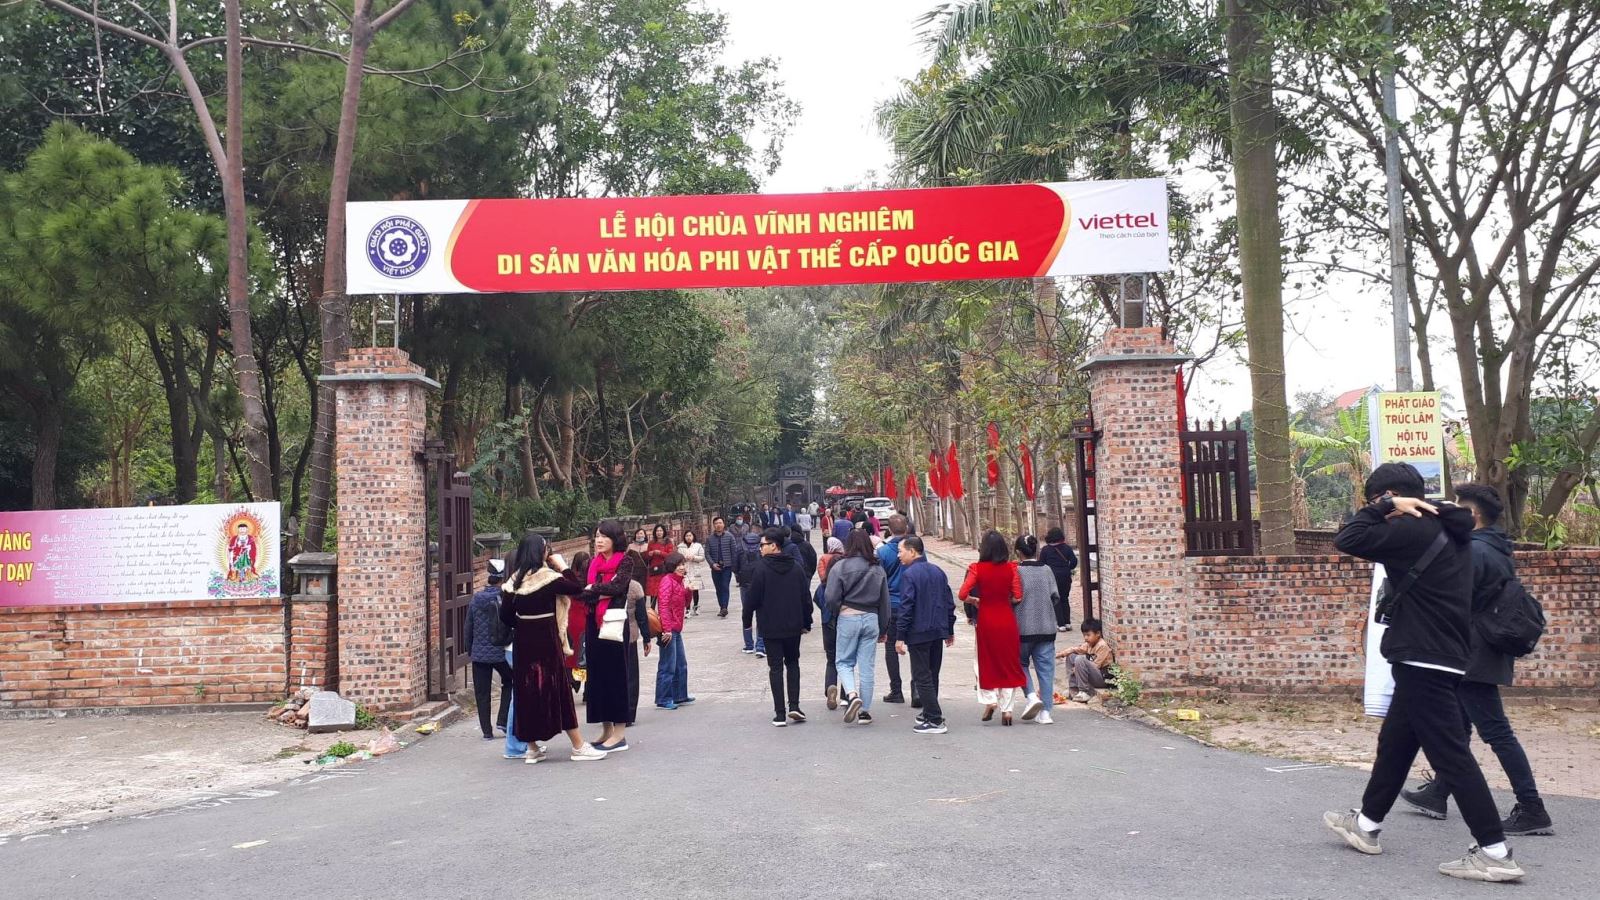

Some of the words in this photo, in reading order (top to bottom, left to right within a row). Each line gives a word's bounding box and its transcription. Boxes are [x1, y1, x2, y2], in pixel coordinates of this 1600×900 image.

[599, 210, 627, 239] LỄ
[634, 213, 675, 242] HỘI
[682, 211, 748, 237] CHÙA
[754, 210, 811, 235] VĨNH
[819, 206, 914, 233] NGHIÊM
[1078, 212, 1159, 230] viettel
[1116, 231, 1132, 239] cách
[1146, 231, 1160, 239] bạn
[497, 254, 522, 275] DI
[529, 247, 580, 274] SẢN
[587, 249, 636, 273] VĂN
[643, 248, 692, 272] HÓA
[700, 250, 740, 271] PHI
[747, 245, 791, 275] VẬT
[798, 239, 841, 269] THỂ
[849, 238, 897, 267] CẤP
[905, 236, 970, 267] QUỐC
[978, 241, 1019, 262] GIA
[399, 264, 416, 275] NAM
[1385, 396, 1410, 412] PHẬT
[1412, 395, 1435, 408] GIÁO
[1385, 411, 1411, 424] TRÚC
[1412, 411, 1434, 424] LÂM
[1396, 429, 1414, 443] HỘI
[1415, 431, 1429, 443] TỤ
[1409, 443, 1436, 456] SÁNG
[6, 562, 34, 587] DẠY
